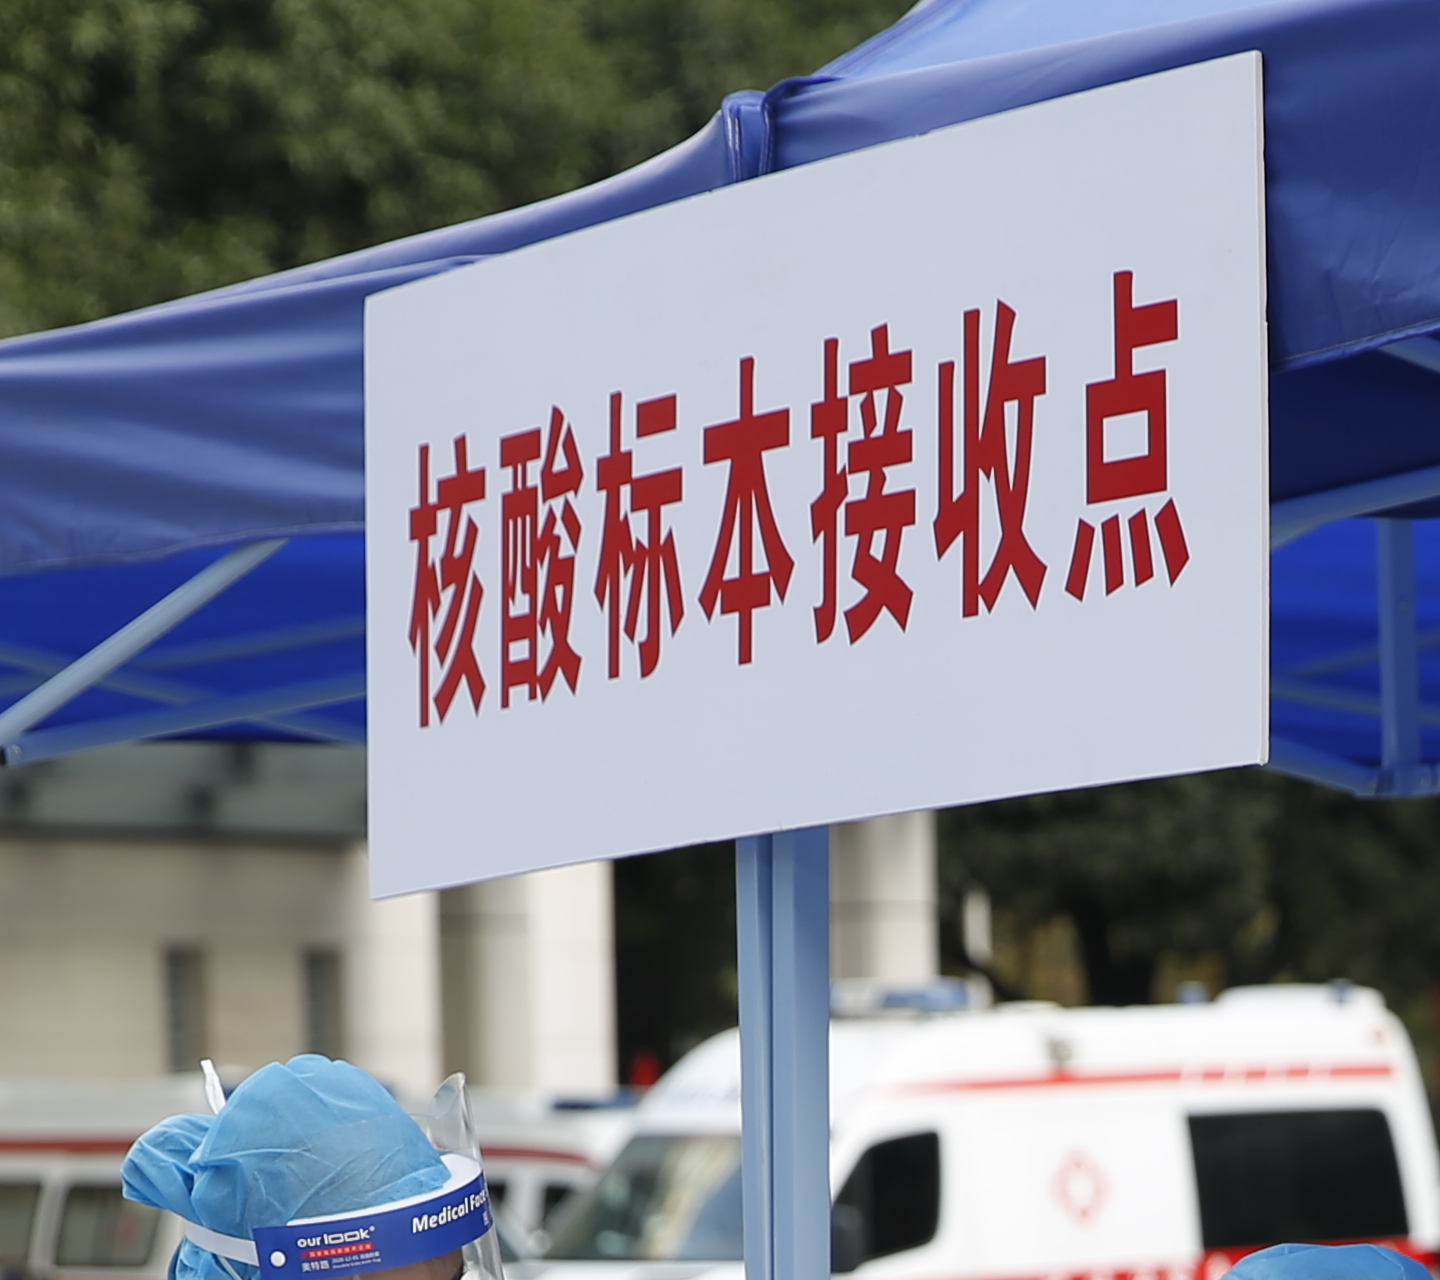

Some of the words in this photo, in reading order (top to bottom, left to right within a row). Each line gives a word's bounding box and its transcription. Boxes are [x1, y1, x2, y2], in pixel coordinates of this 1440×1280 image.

[407, 270, 1191, 729] 核酸标本接收点
[412, 1196, 469, 1234] Medical
